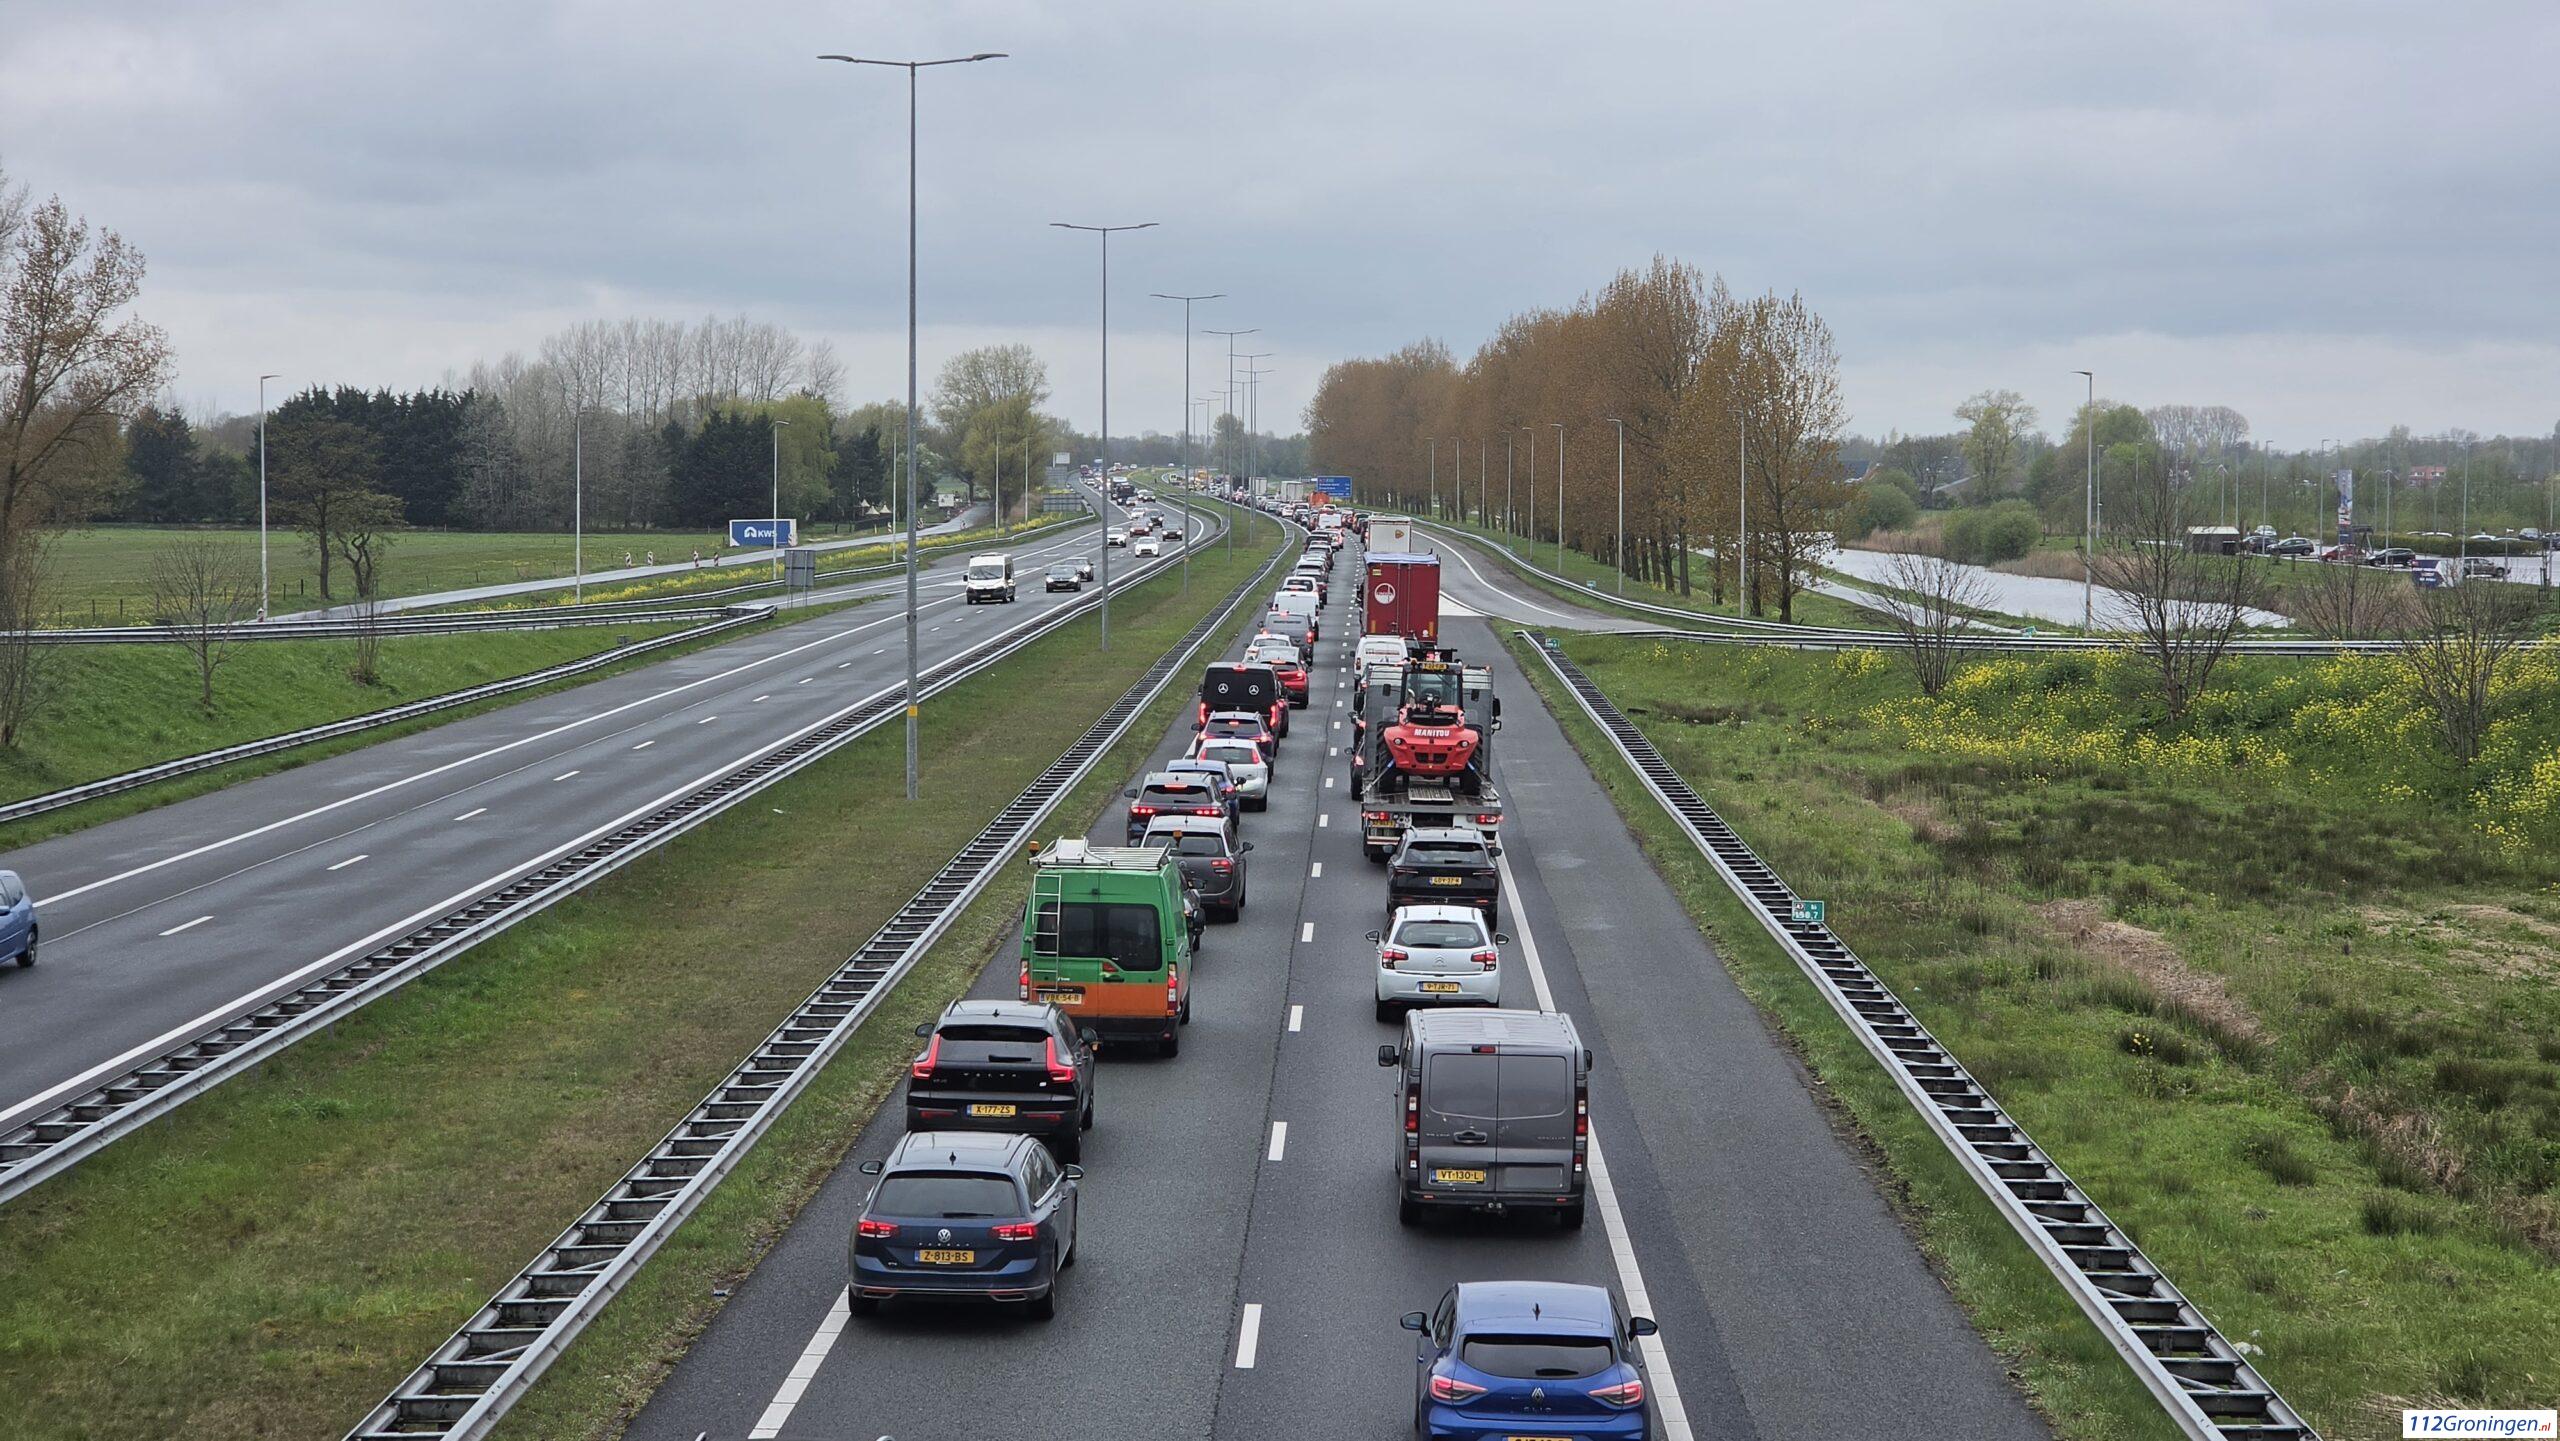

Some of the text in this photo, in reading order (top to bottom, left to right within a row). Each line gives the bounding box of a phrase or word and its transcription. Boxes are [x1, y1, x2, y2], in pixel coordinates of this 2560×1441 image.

[1414, 728, 1450, 737] MANITOU
[976, 1105, 1011, 1114] X-177-ZS
[1440, 1170, 1479, 1180] VT-130-L
[924, 1251, 969, 1261] Z-813-BS
